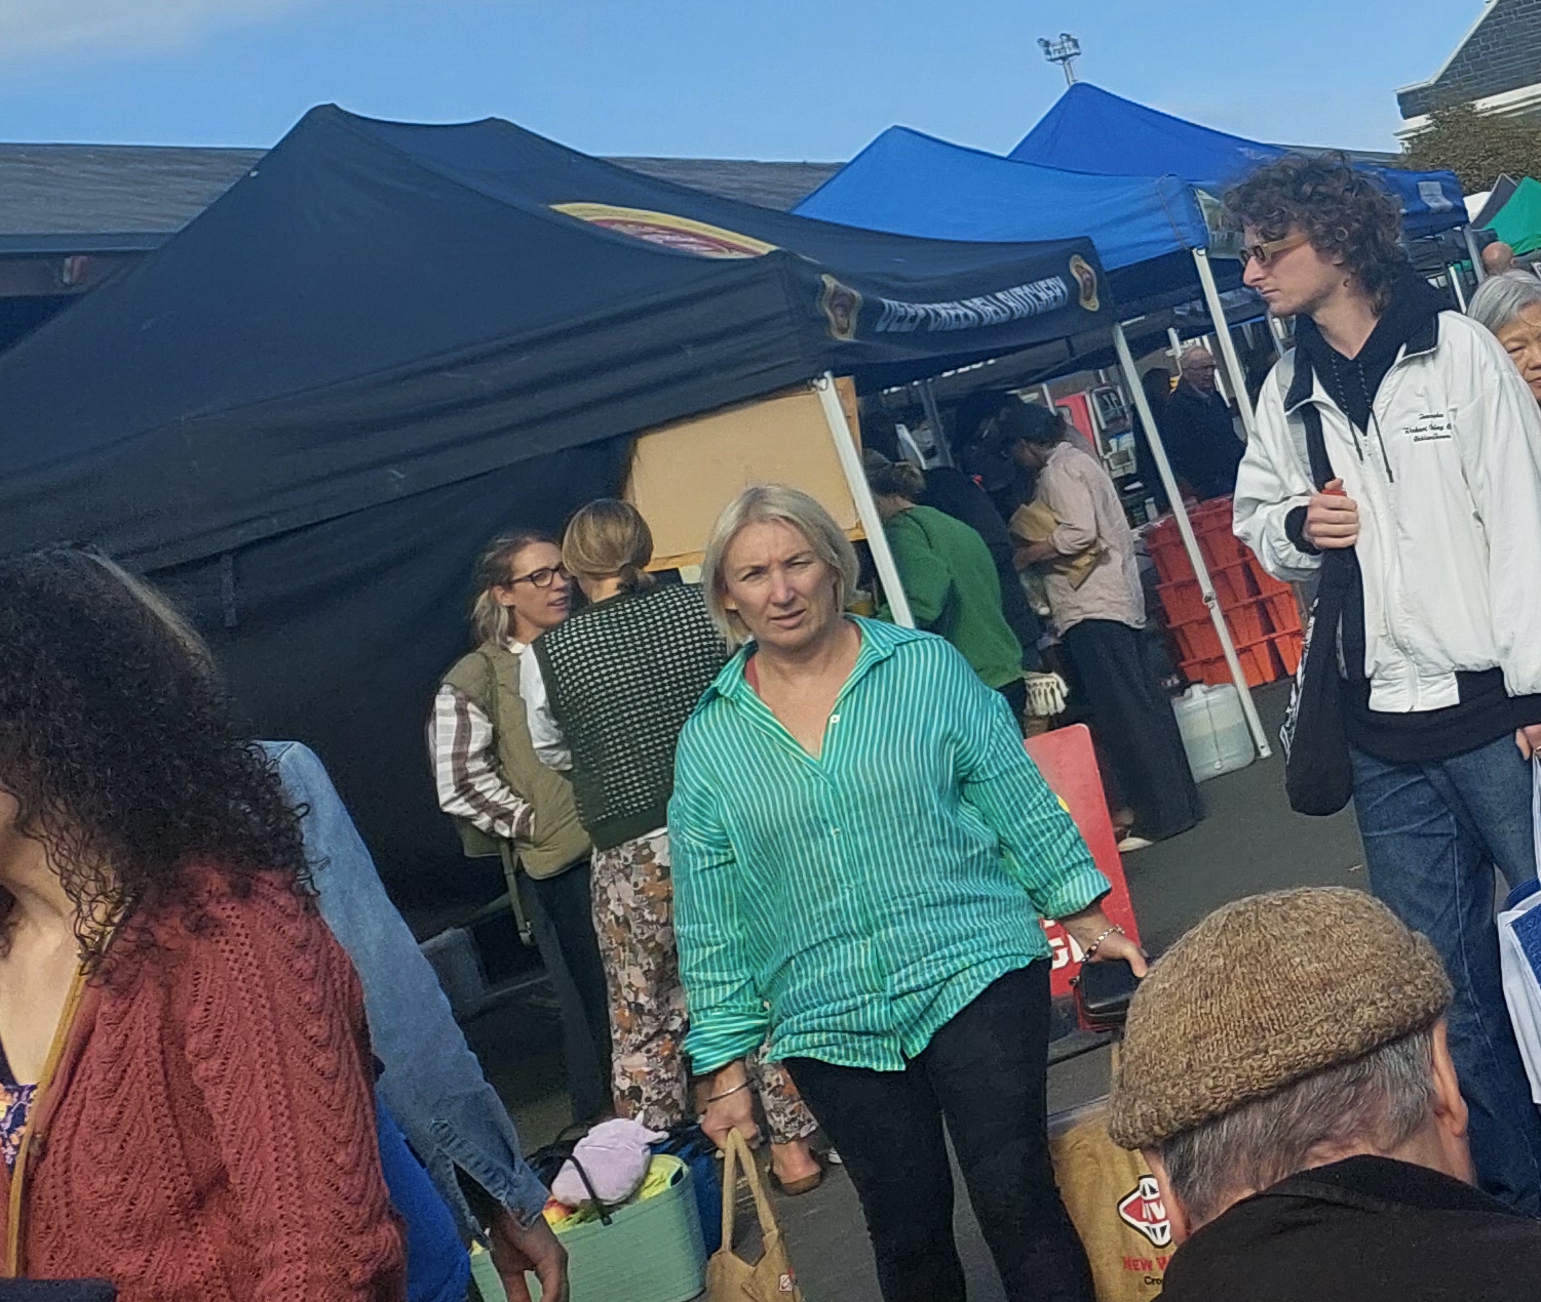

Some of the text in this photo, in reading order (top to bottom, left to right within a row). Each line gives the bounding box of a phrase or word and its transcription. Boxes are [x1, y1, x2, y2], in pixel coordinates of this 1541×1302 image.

[875, 298, 926, 332] DEEP
[995, 275, 1069, 321] BUTCHERY
[1123, 1256, 1153, 1271] NEW
[1144, 1275, 1165, 1286] Cro
